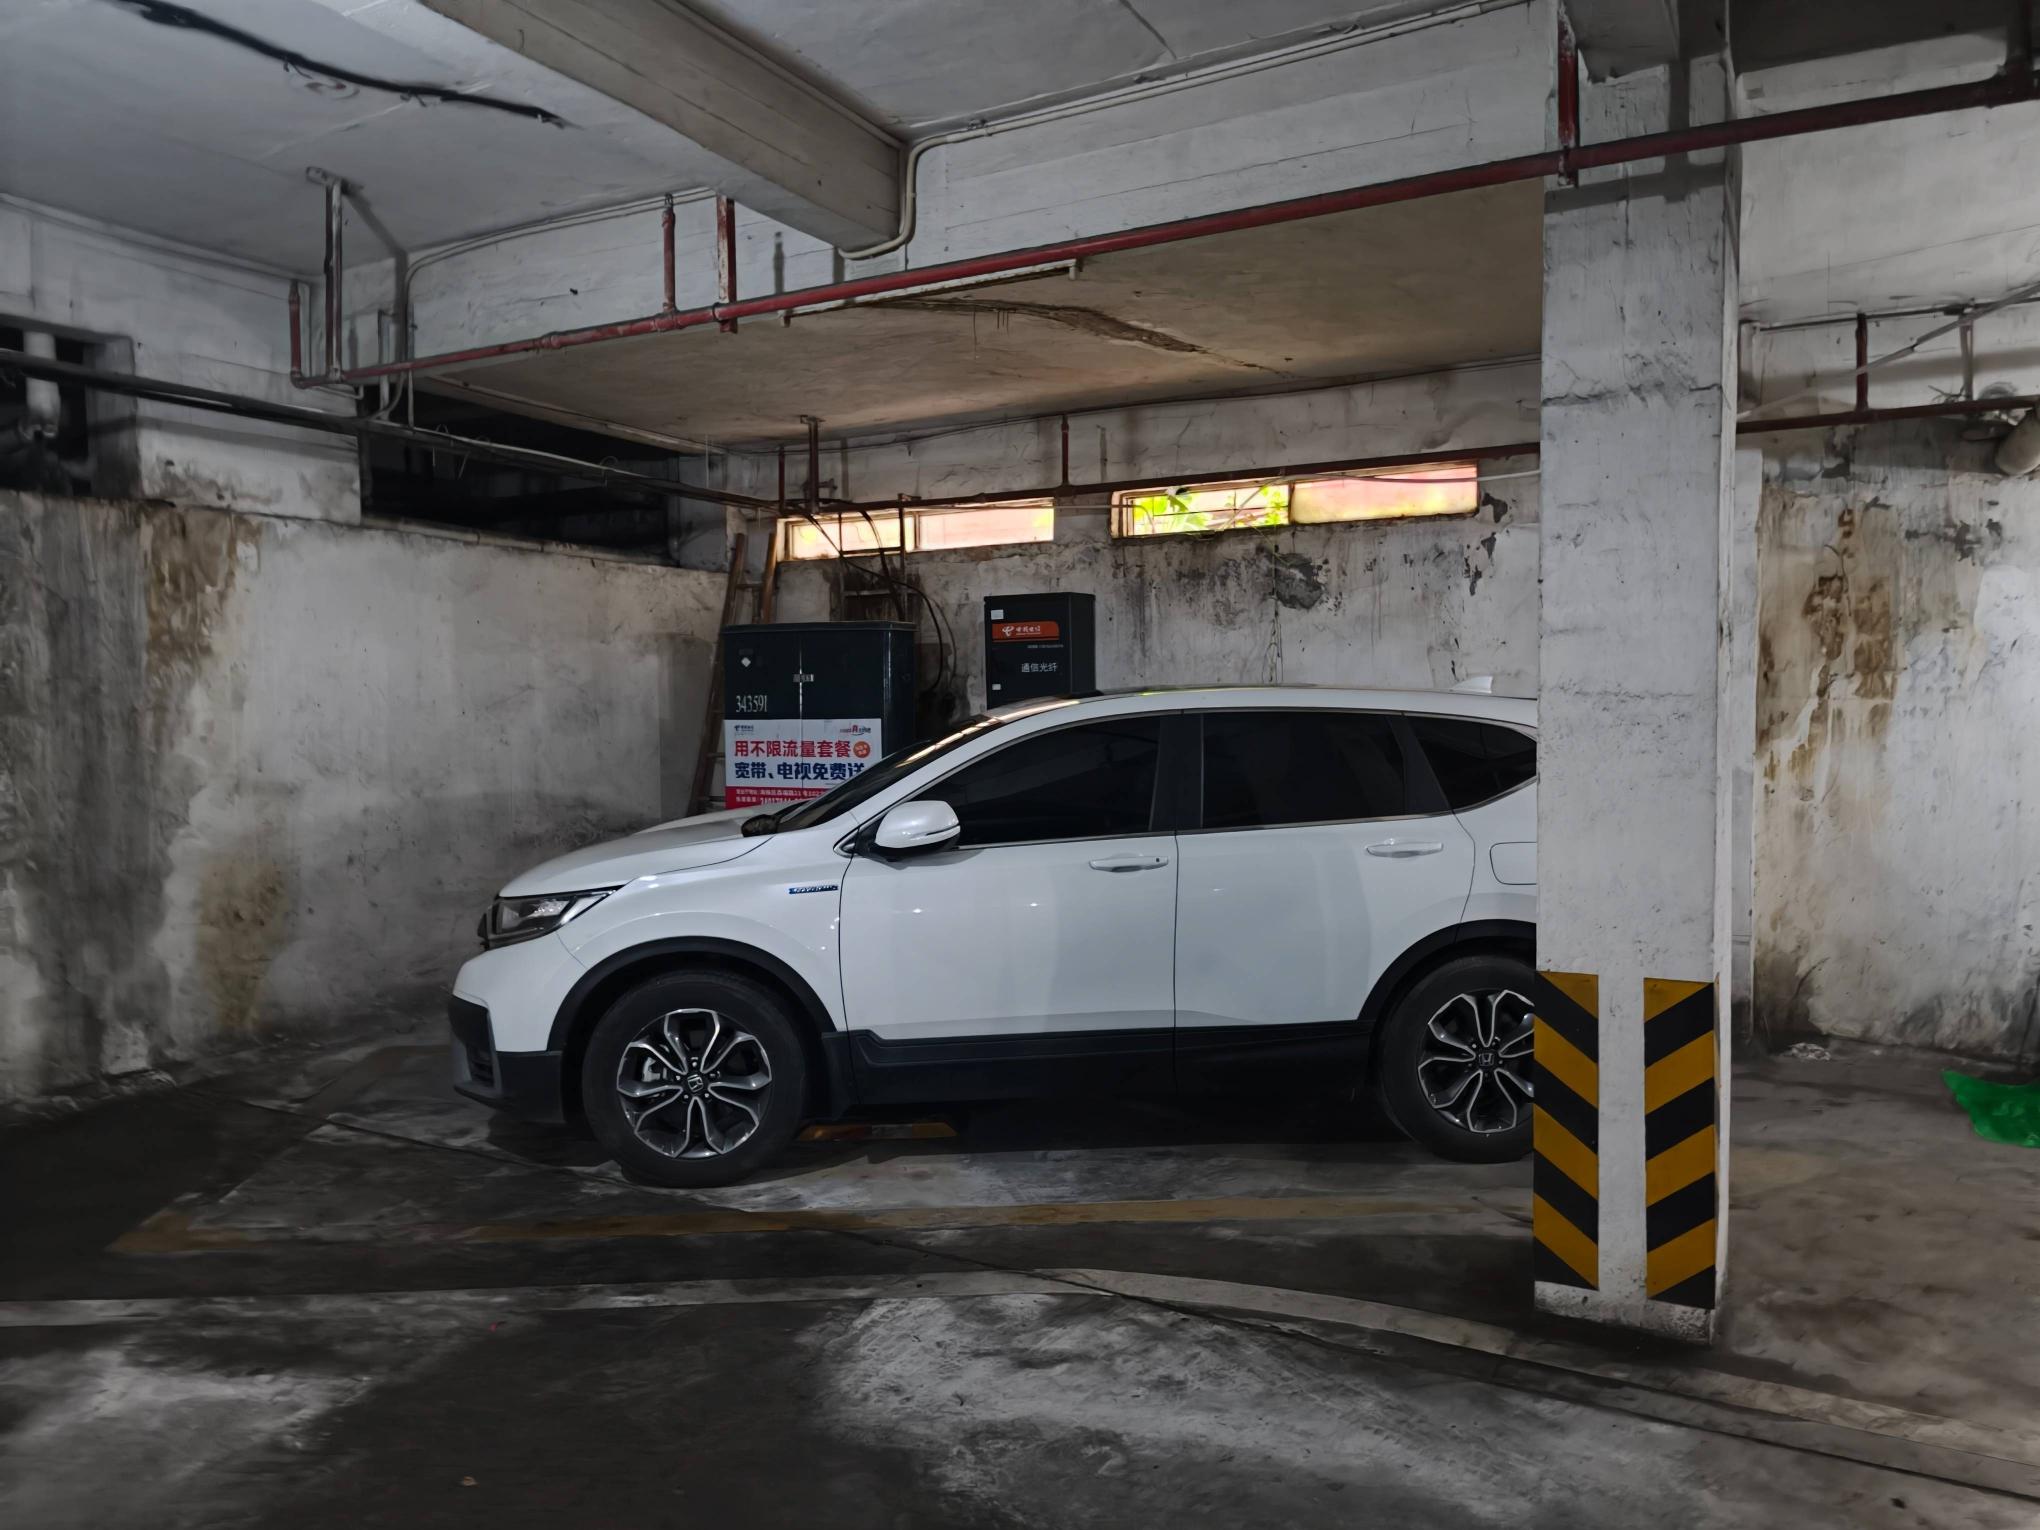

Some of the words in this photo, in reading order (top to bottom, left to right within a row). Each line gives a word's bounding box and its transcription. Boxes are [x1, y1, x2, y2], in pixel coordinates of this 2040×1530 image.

[1021, 662, 1058, 673] 通信光纤
[735, 694, 768, 713] 343591
[734, 740, 851, 758] 用不限流量套餐
